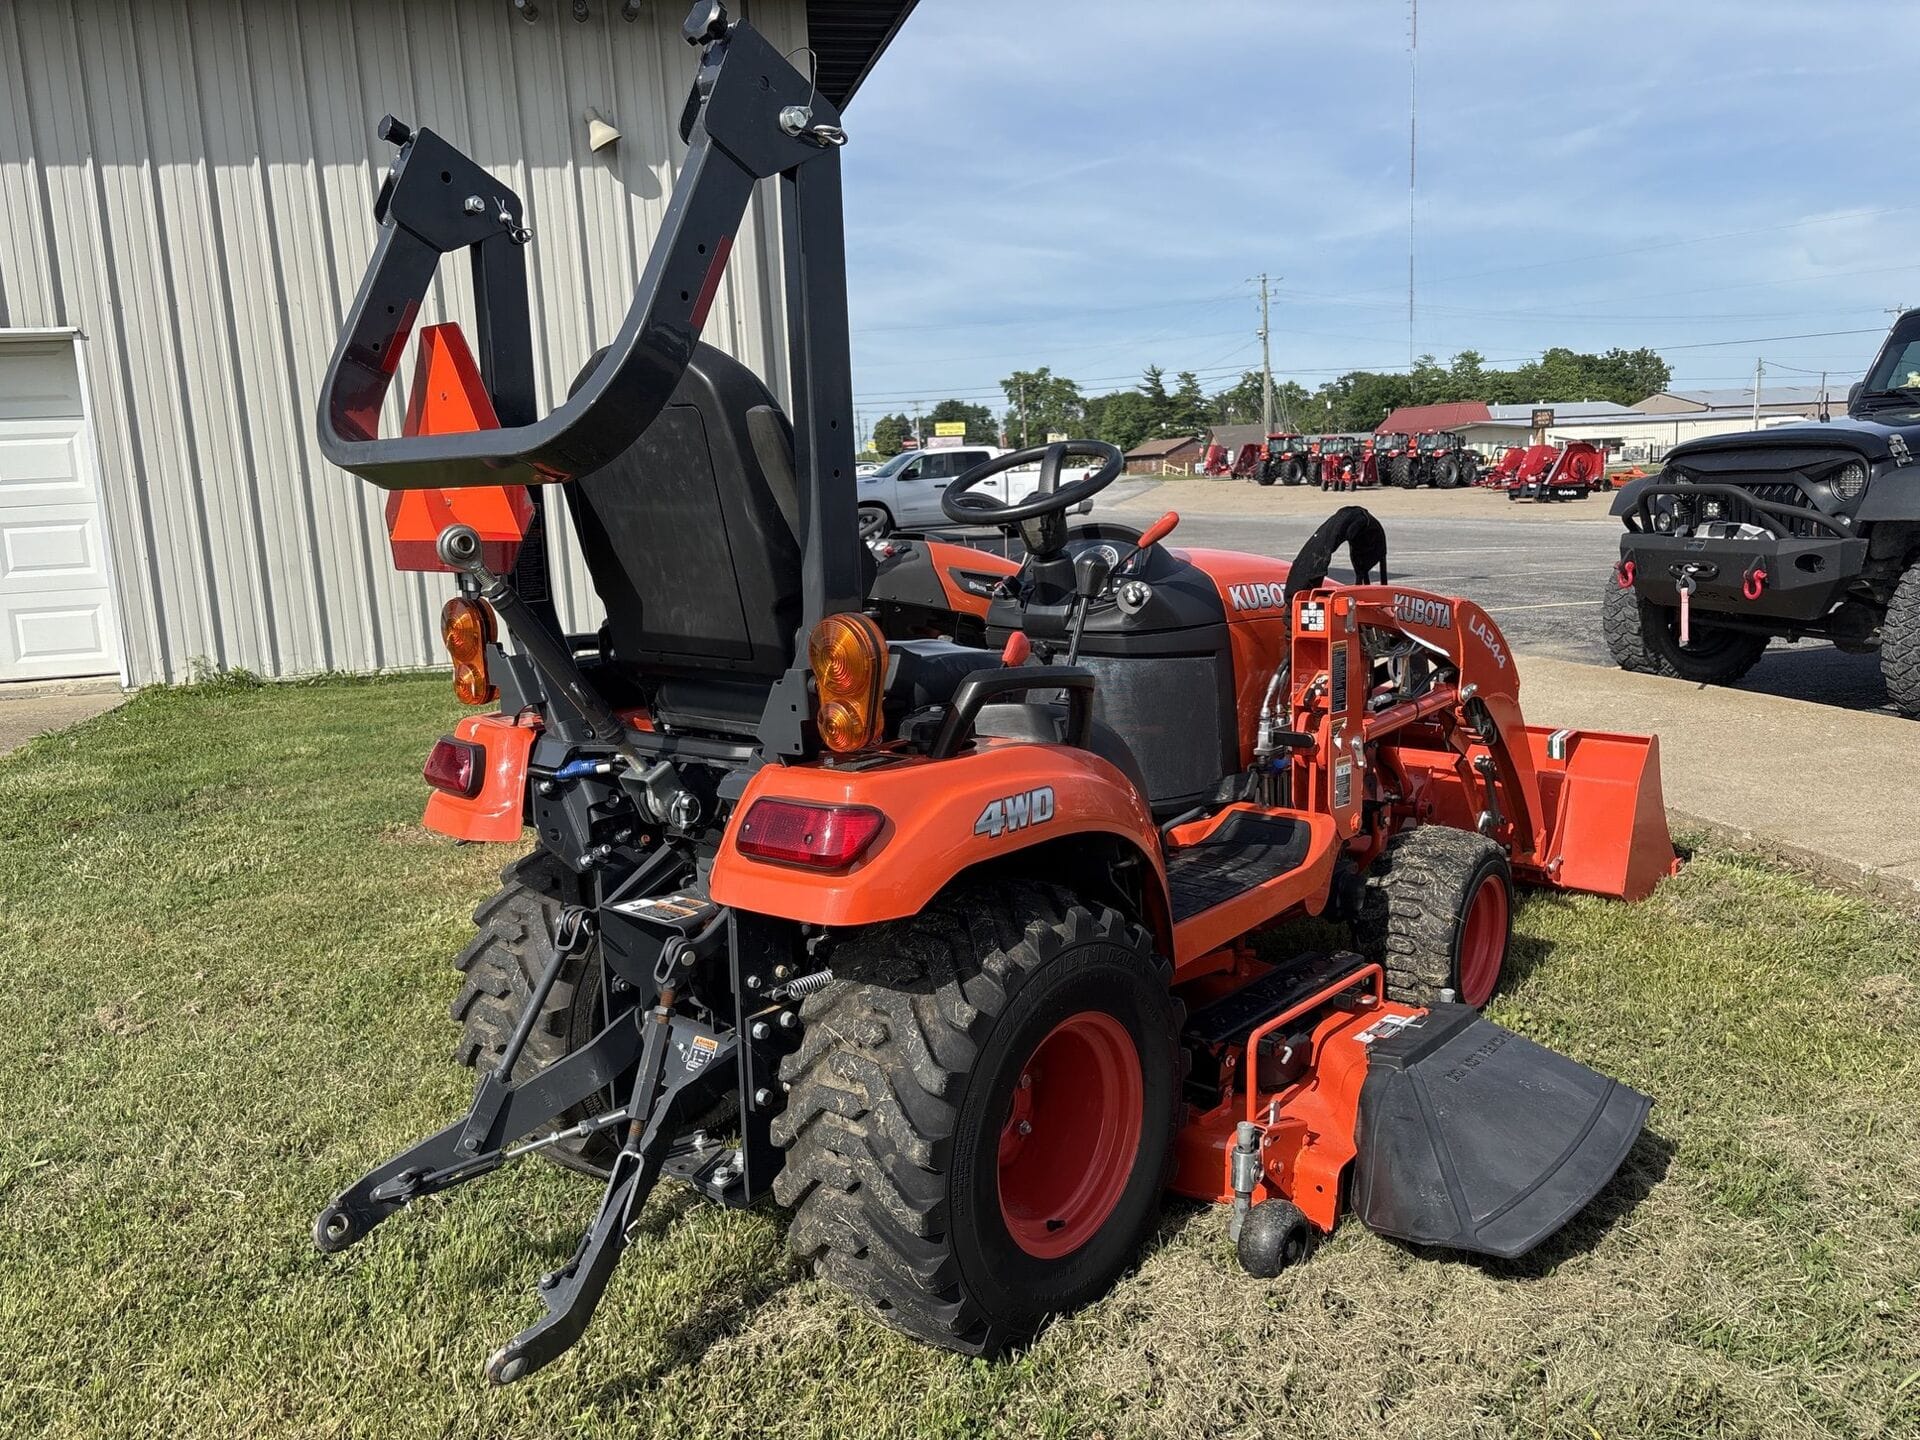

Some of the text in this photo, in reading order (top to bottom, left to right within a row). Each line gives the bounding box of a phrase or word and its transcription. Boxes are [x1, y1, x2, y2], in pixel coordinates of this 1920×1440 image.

[1228, 582, 1287, 611] KUBO
[1393, 593, 1451, 629] KUBOTA
[1468, 614, 1506, 669] LA344
[974, 785, 1055, 838] 4WD
